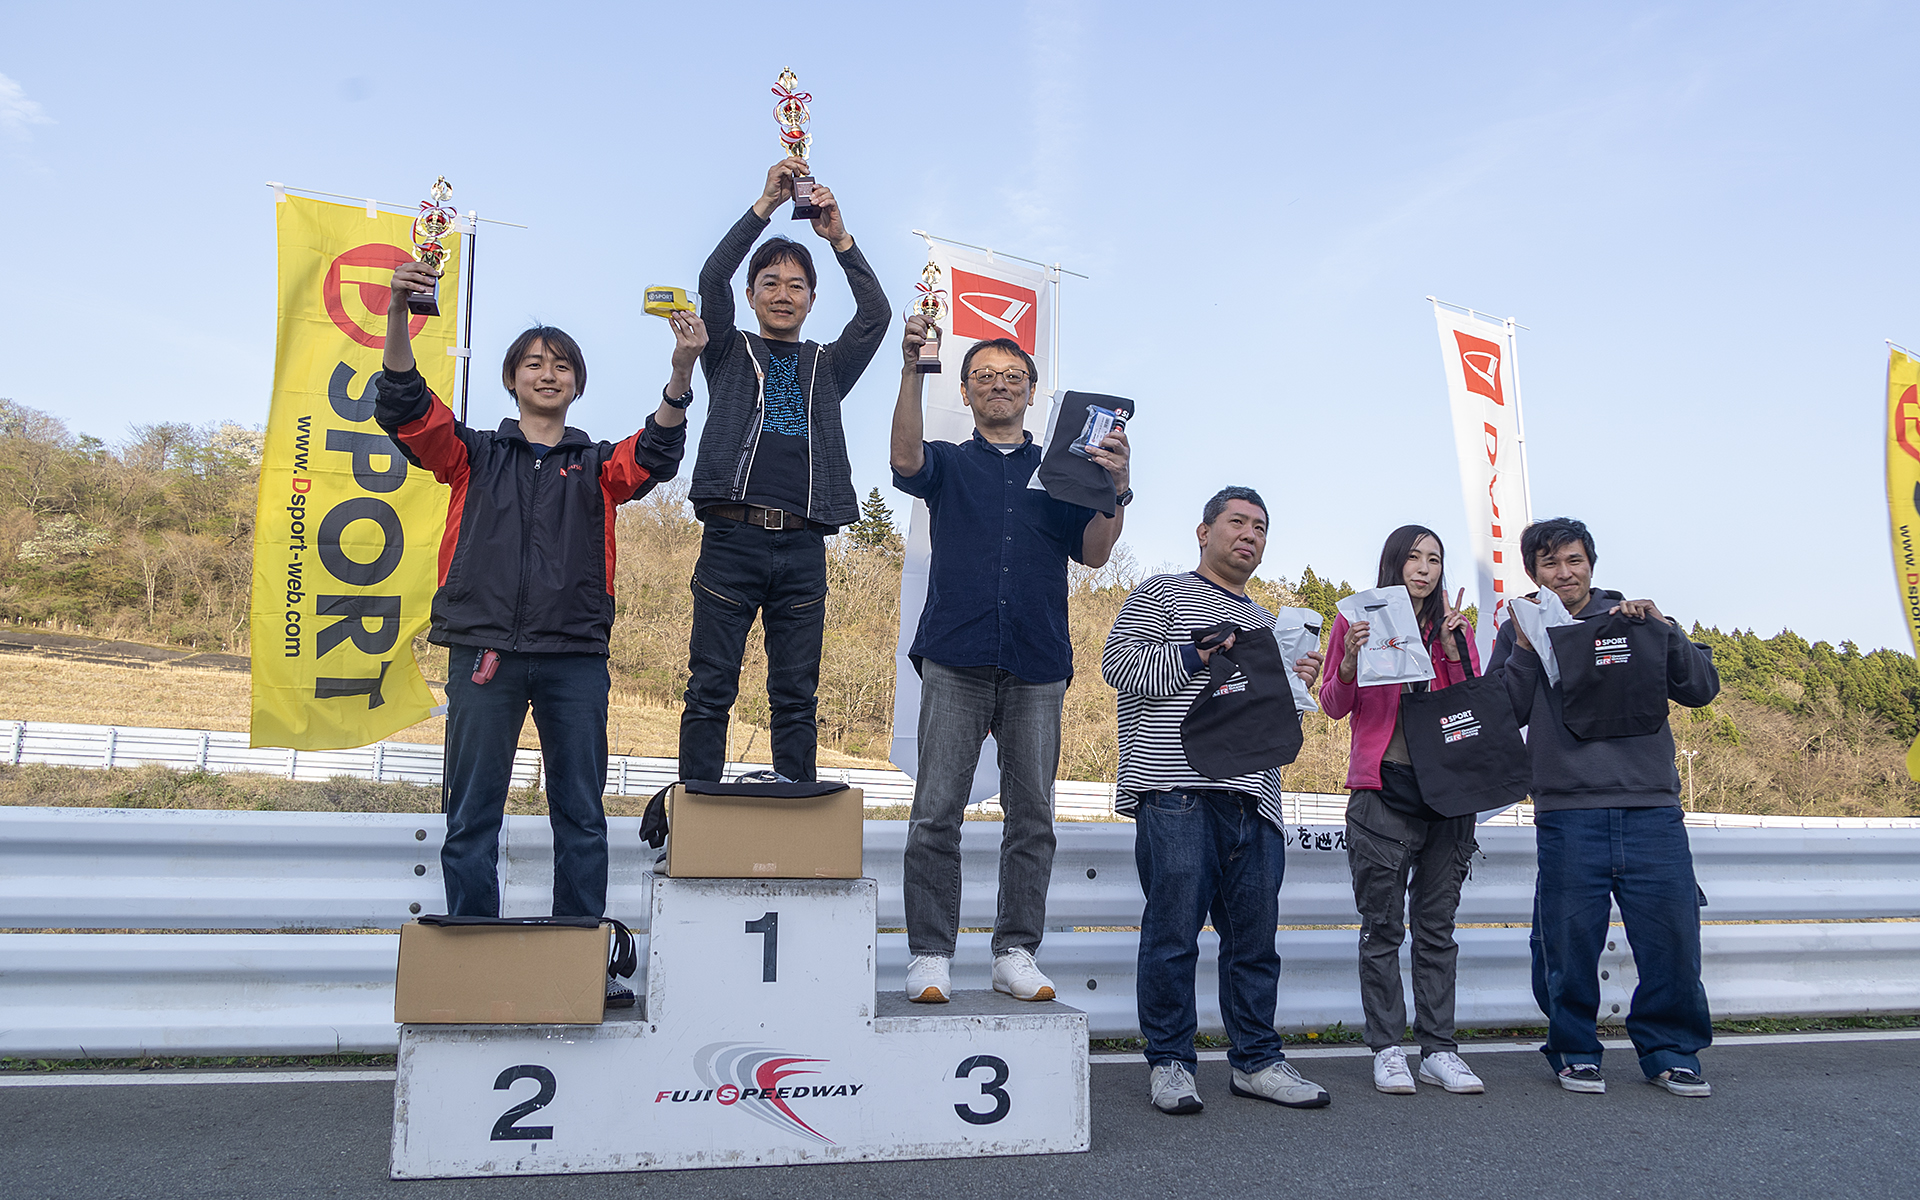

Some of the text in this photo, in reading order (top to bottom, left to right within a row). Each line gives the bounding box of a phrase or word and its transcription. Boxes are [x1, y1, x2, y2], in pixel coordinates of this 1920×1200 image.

[285, 415, 312, 658] www.Dsport-web.com
[315, 361, 408, 710] SPORT
[1602, 637, 1627, 645] SPORT
[1448, 710, 1472, 722] SPORT
[745, 912, 778, 982] 1
[490, 1065, 556, 1141] 2
[655, 1084, 863, 1104] FUJI SPEEDWAY
[954, 1055, 1010, 1125] 3
